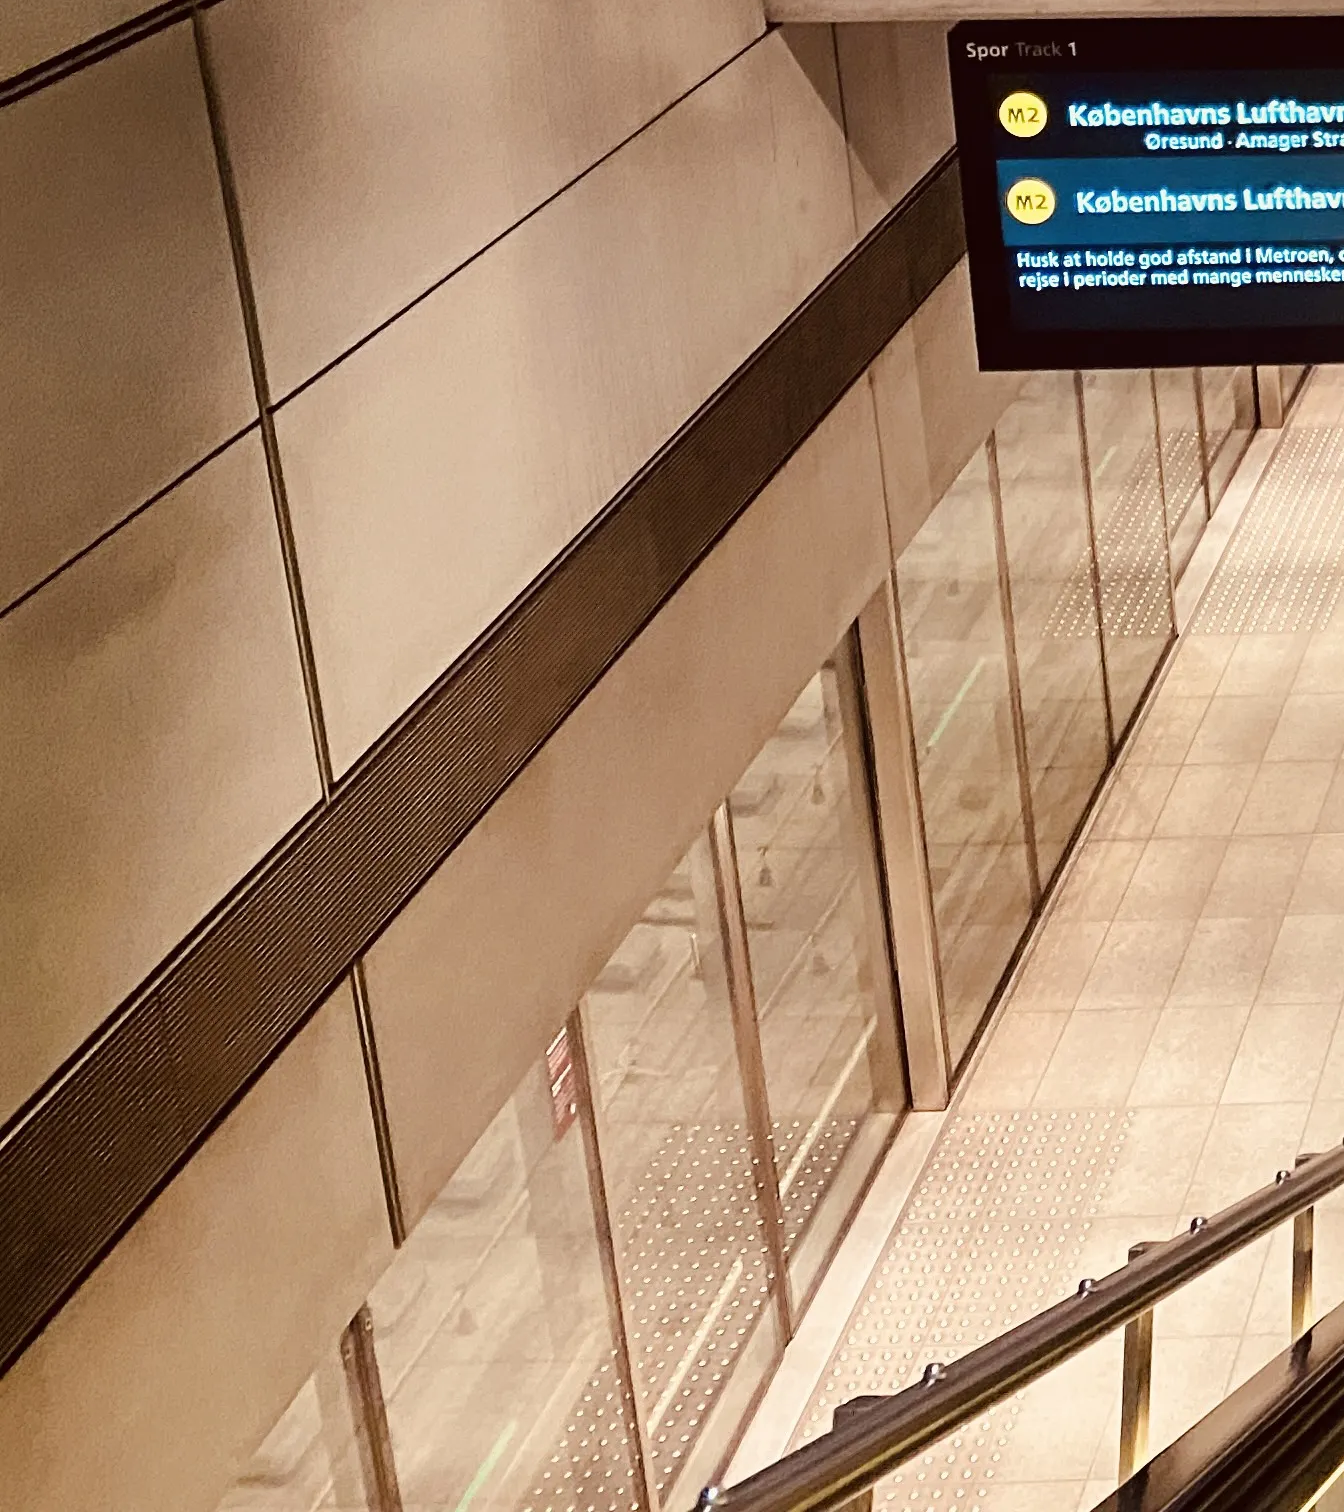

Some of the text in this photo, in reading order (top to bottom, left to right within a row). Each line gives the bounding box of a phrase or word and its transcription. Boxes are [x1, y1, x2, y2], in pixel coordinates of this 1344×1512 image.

[966, 40, 1077, 61] Spor Track 1
[1007, 107, 1040, 124] M2
[1068, 102, 1231, 127] Københavns
[1145, 132, 1224, 151] Øresund
[1235, 132, 1309, 153] Amager
[1015, 194, 1049, 211] M2
[1076, 188, 1238, 214] Københavns
[1016, 250, 1060, 268] Husk
[1063, 251, 1081, 268] at
[1085, 250, 1135, 268] holde
[1138, 249, 1173, 270] god
[1176, 248, 1241, 265] afstand
[1245, 247, 1251, 264] i
[1255, 247, 1335, 265] Metroen,
[1018, 271, 1060, 292] rejse
[1063, 271, 1070, 287] i
[1073, 270, 1147, 290] perioder
[1150, 268, 1189, 285] med
[1192, 269, 1252, 288] mange
